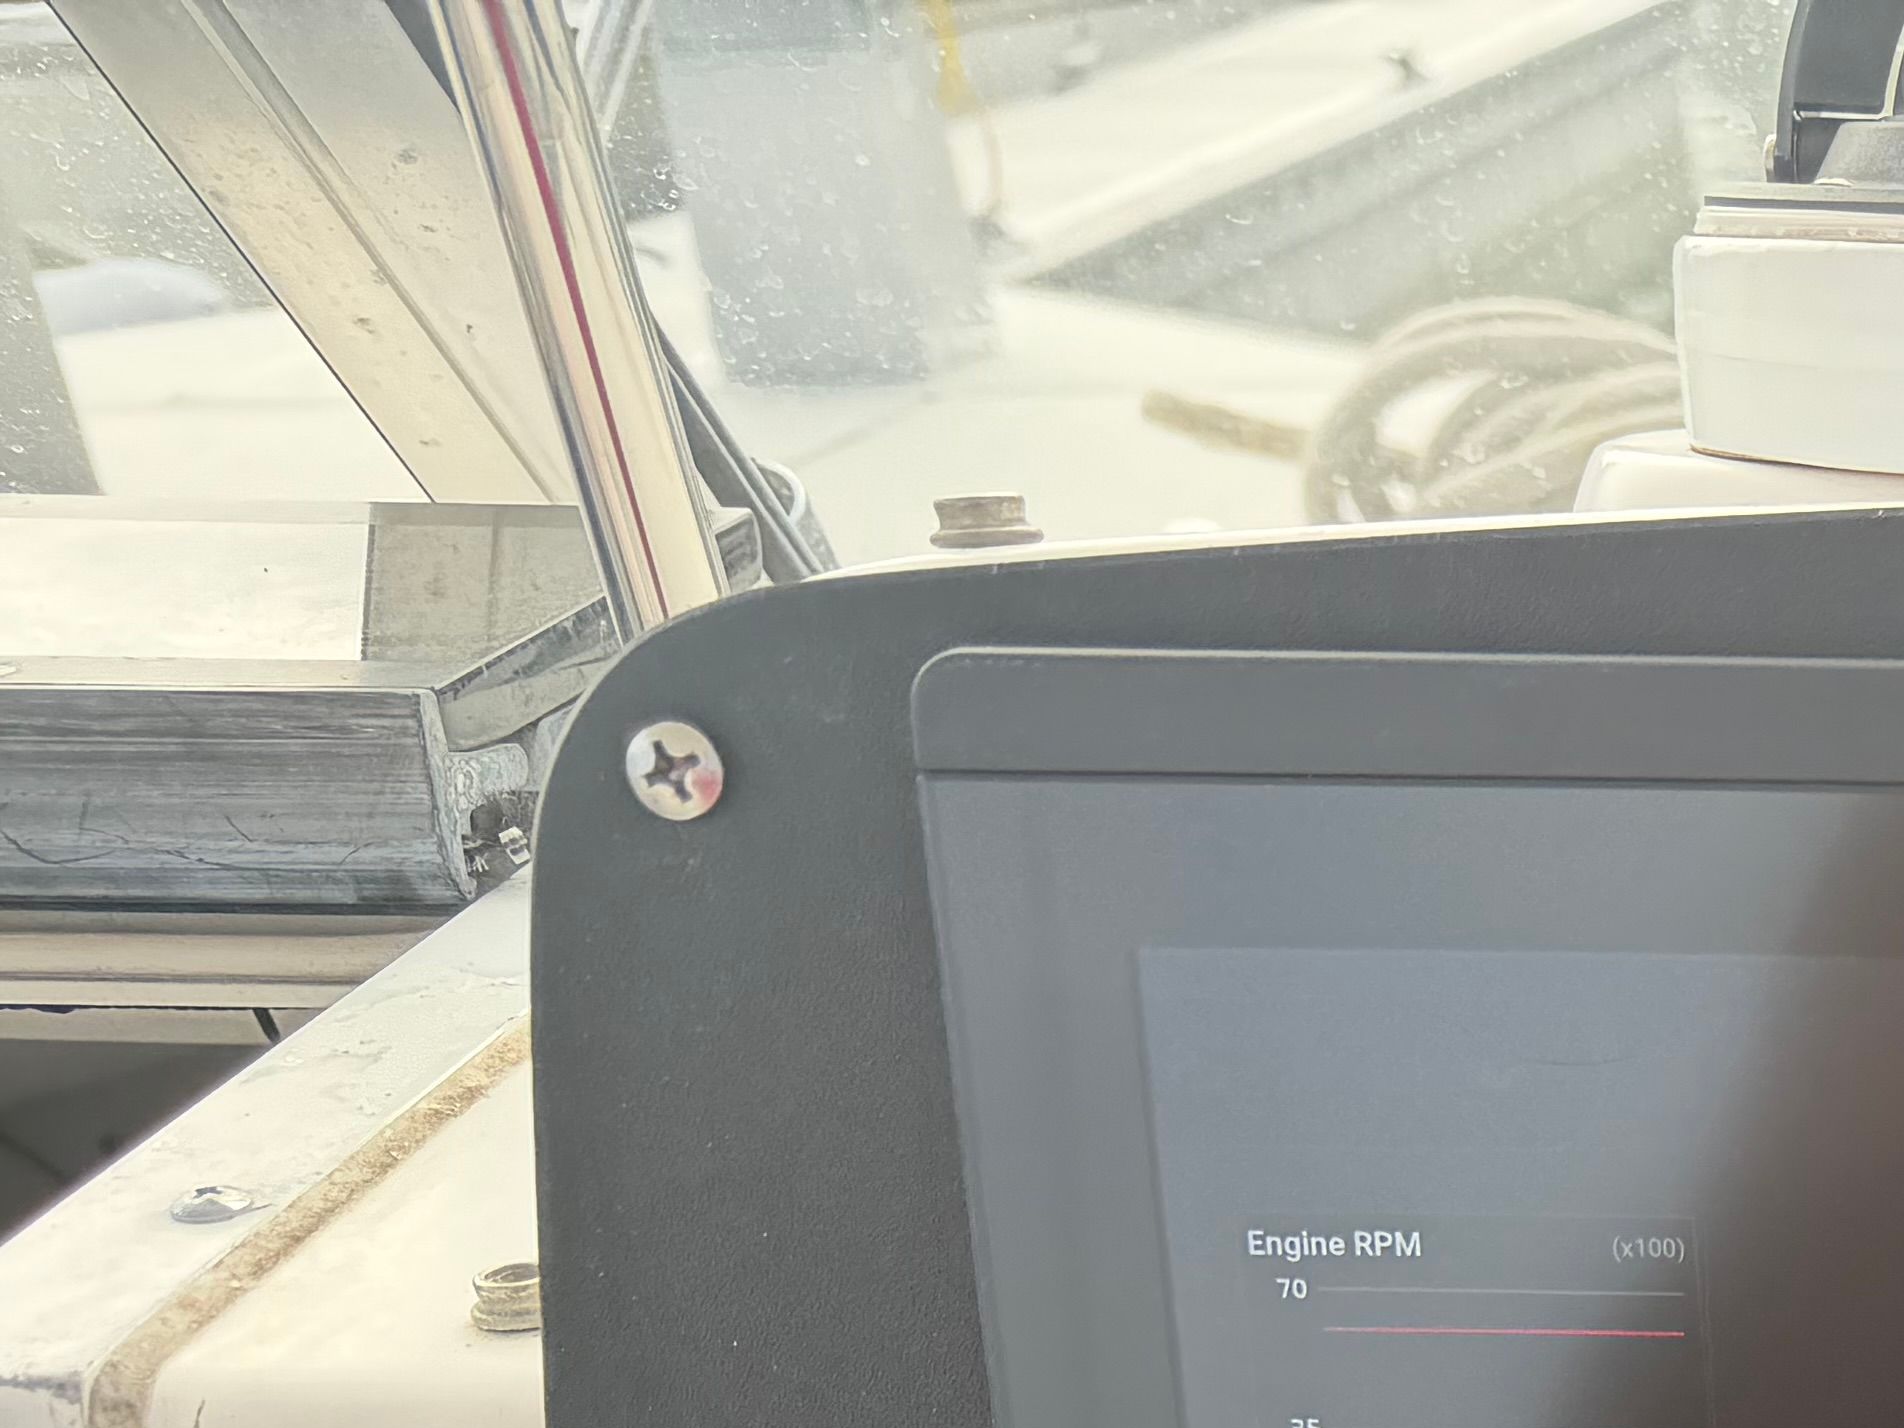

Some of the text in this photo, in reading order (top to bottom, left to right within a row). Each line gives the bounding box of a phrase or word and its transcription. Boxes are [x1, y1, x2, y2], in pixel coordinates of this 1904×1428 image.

[1247, 1229, 1422, 1259] Engine RPM
[1613, 1238, 1685, 1263] (x100)
[1276, 1280, 1307, 1299] 70
